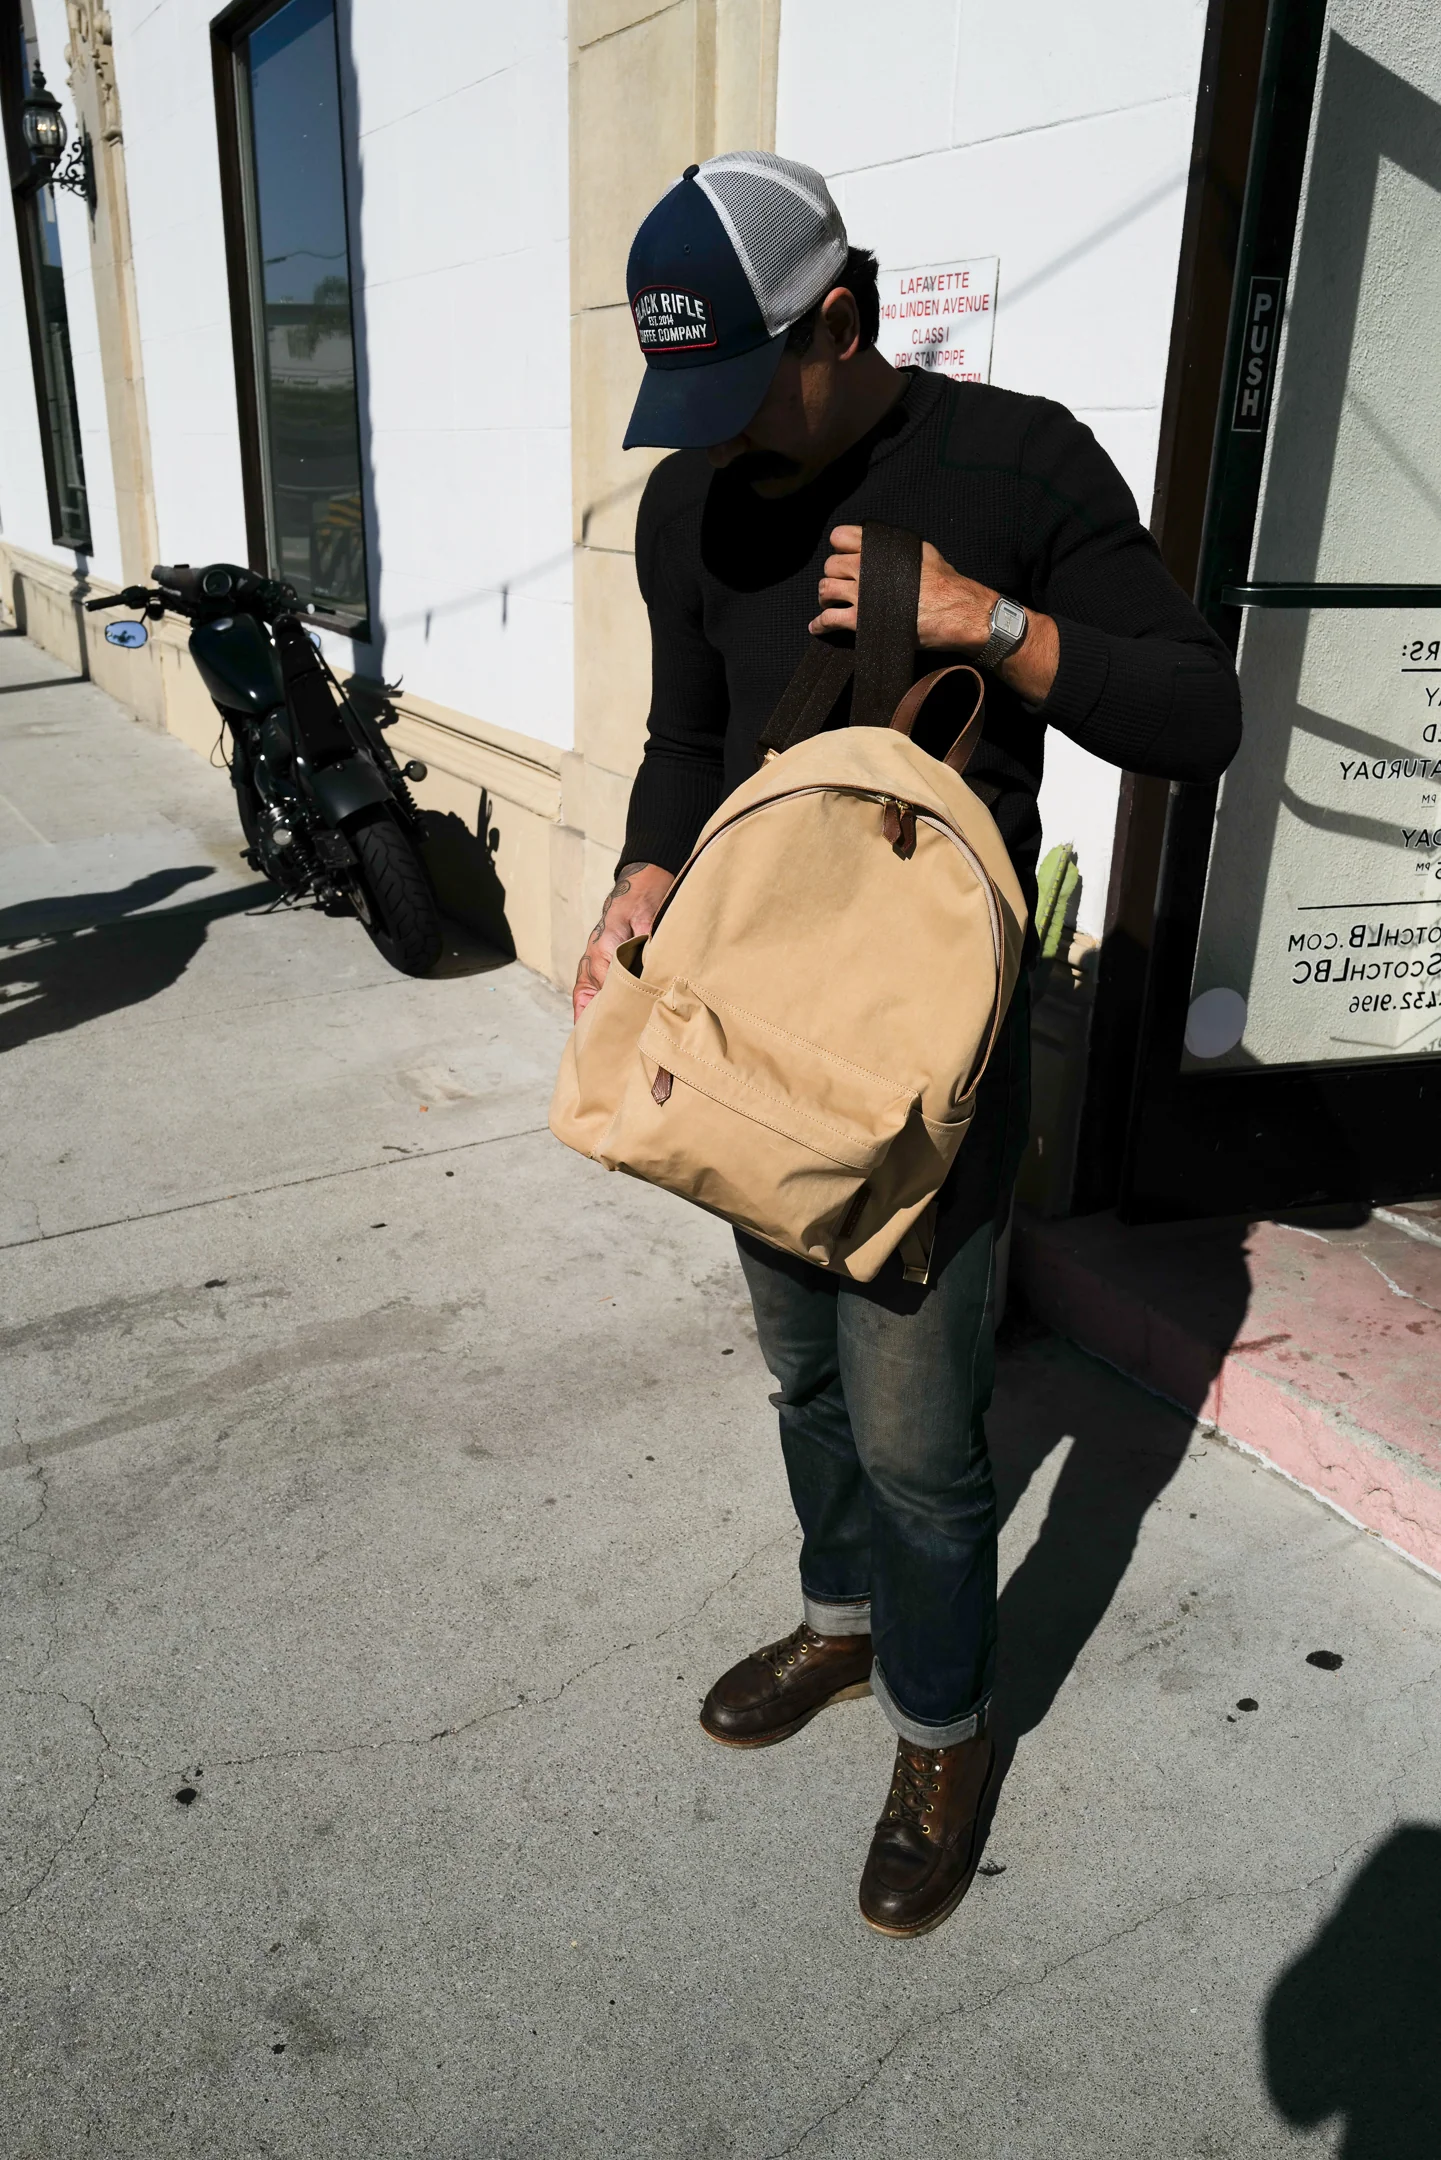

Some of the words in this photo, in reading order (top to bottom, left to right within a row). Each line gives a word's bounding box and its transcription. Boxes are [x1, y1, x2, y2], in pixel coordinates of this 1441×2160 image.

[900, 271, 970, 295] LAFAYETTE
[660, 292, 706, 321] RIFLE
[881, 304, 897, 320] 140
[899, 299, 940, 319] LINDEN
[942, 294, 990, 315] AVENUE
[659, 314, 674, 326] 2014
[658, 323, 707, 342] COMPANY
[912, 327, 944, 345] CLASS
[894, 352, 913, 369] DRY
[914, 349, 965, 367] STANDPIPE
[1241, 293, 1273, 417] PUSH
